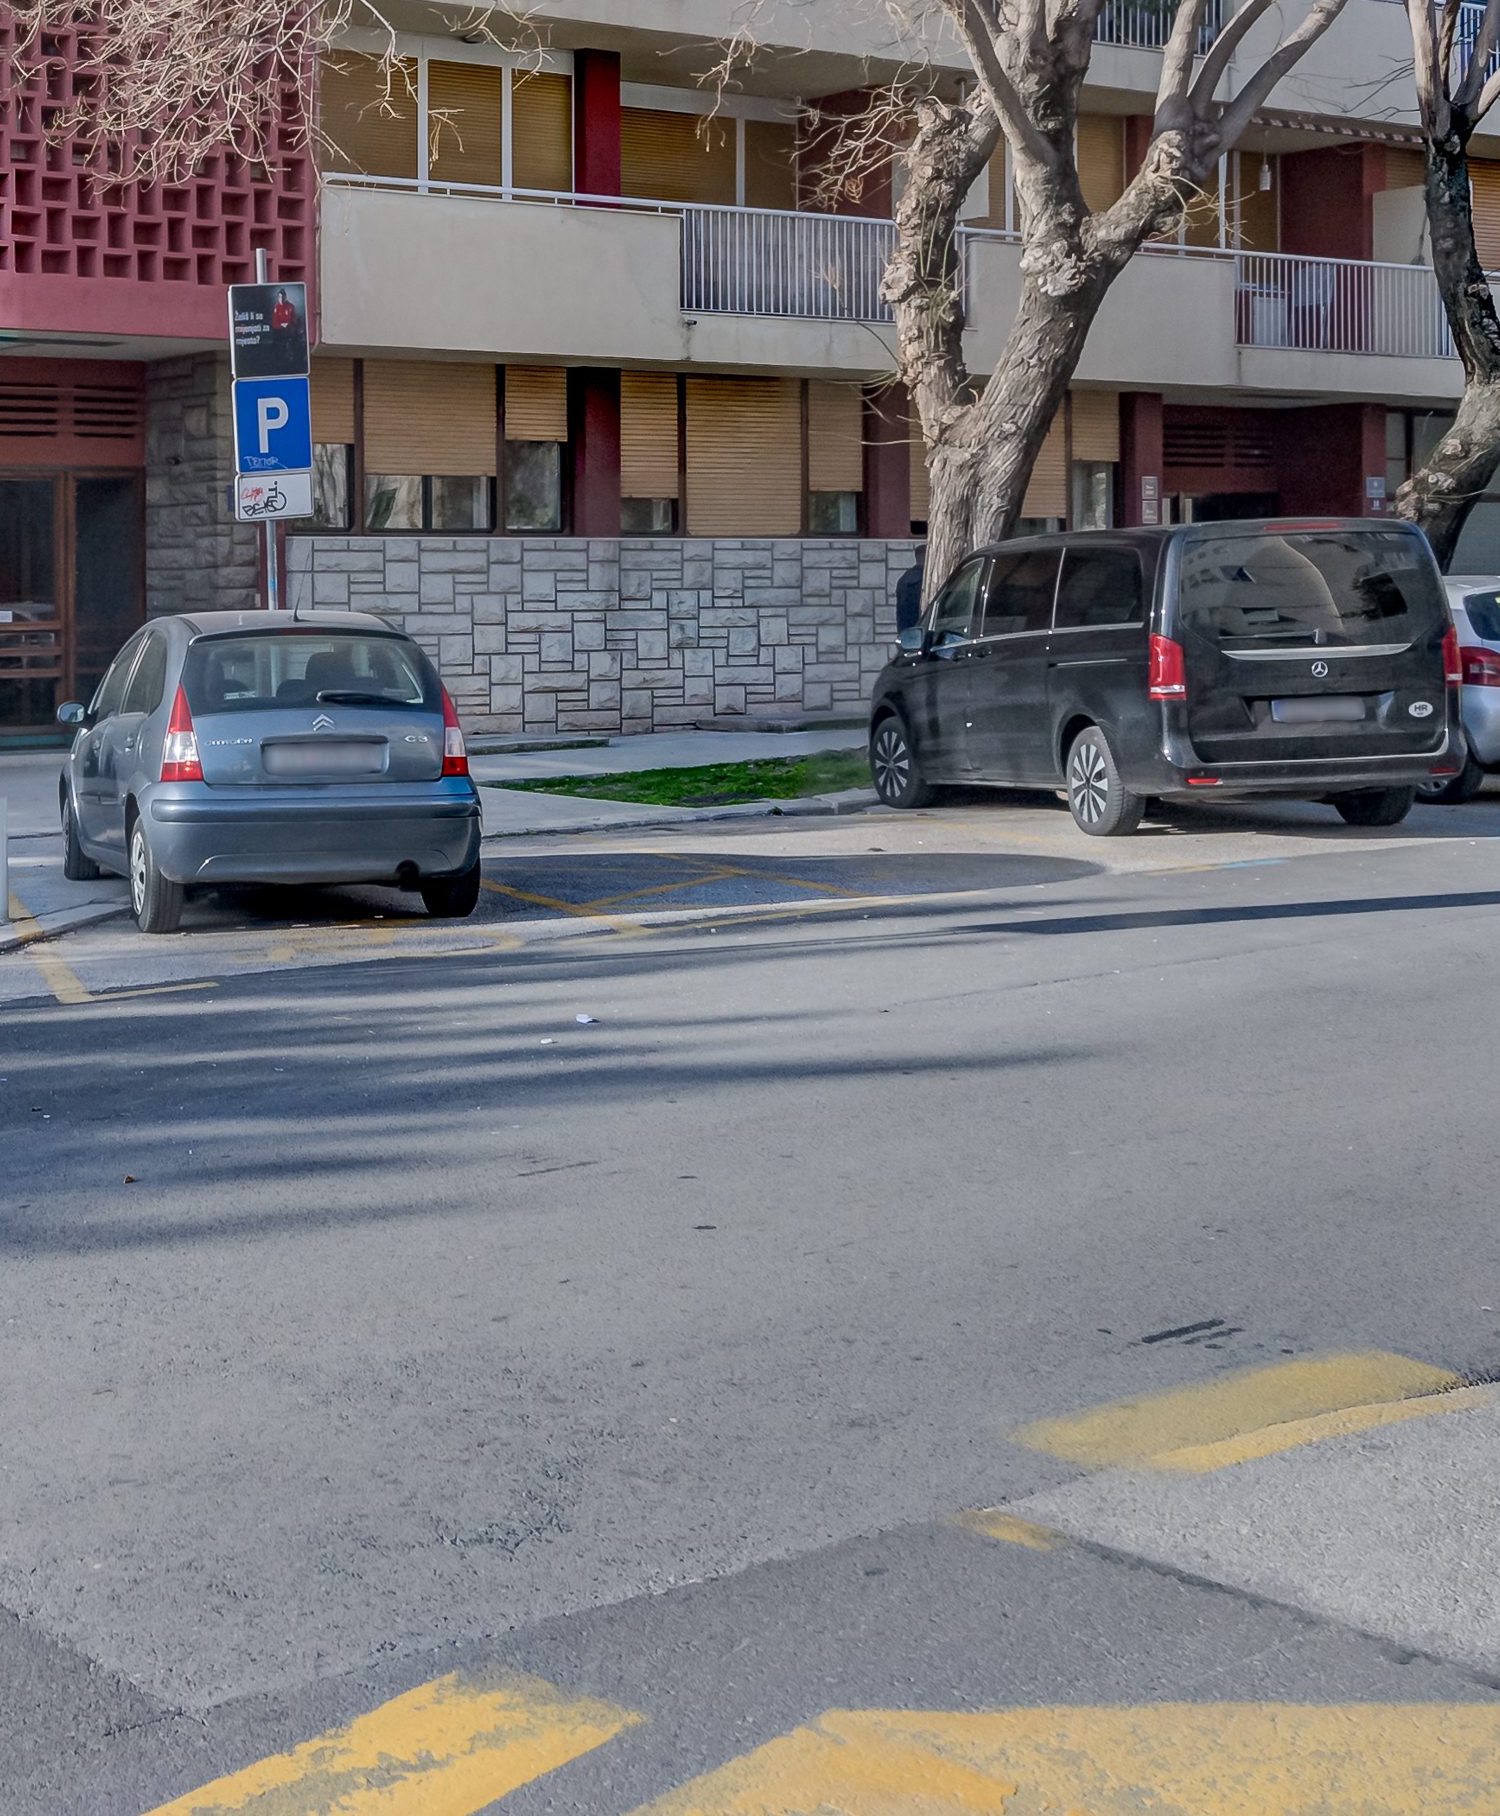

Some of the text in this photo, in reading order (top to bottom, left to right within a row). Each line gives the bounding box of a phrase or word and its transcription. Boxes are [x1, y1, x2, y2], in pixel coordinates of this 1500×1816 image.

[257, 397, 289, 454] P
[1414, 704, 1429, 712] HR
[404, 735, 429, 743] C3
